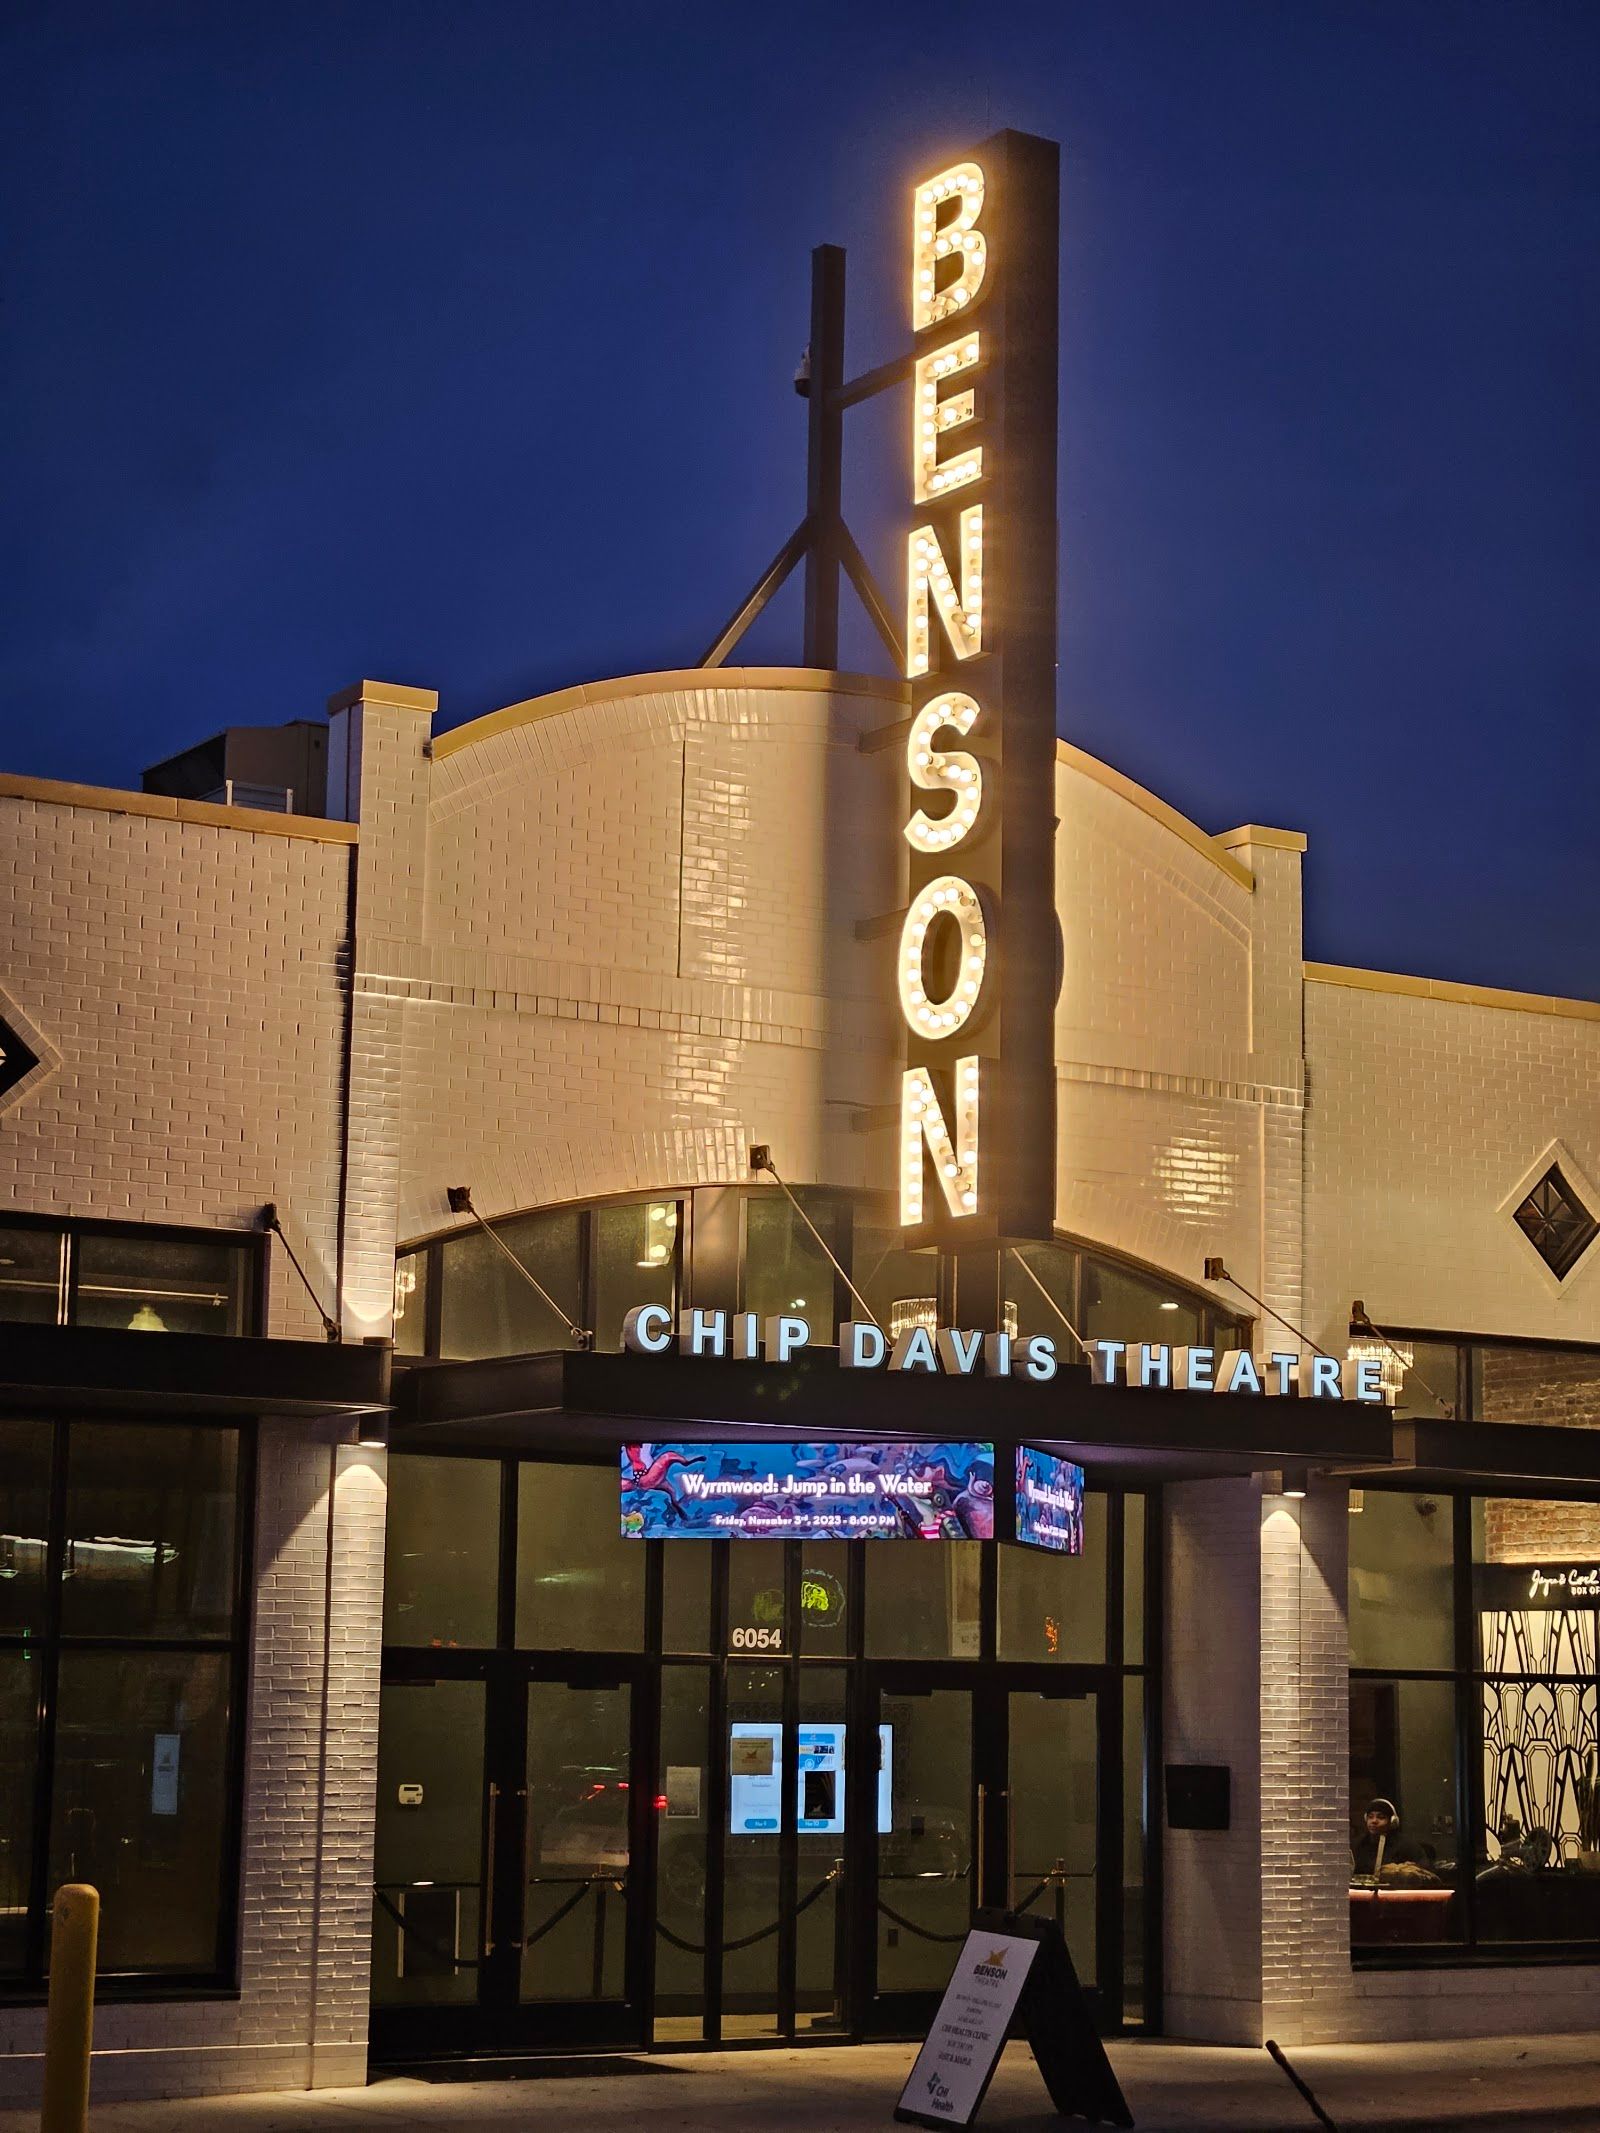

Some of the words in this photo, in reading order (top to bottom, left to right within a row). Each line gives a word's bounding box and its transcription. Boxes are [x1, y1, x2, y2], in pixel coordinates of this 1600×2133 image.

[897, 160, 988, 1228] BENSON
[630, 1303, 810, 1363] CHIP
[846, 1320, 1058, 1383] DAVIS
[1090, 1340, 1384, 1401] THEATRE
[682, 1473, 779, 1498] Wyrmwood:
[781, 1474, 828, 1498] Jump
[830, 1476, 847, 1494] in
[848, 1473, 876, 1494] the
[878, 1474, 932, 1494] Water
[714, 1514, 746, 1527] Friday,
[748, 1515, 792, 1526] November
[813, 1515, 842, 1526] 2023
[849, 1515, 877, 1526] 8:00
[879, 1515, 896, 1526] PM
[1571, 1586, 1588, 1596] BOX
[732, 1627, 782, 1649] 6054
[973, 1964, 1009, 1980] BENSON
[931, 2097, 954, 2113] Health
